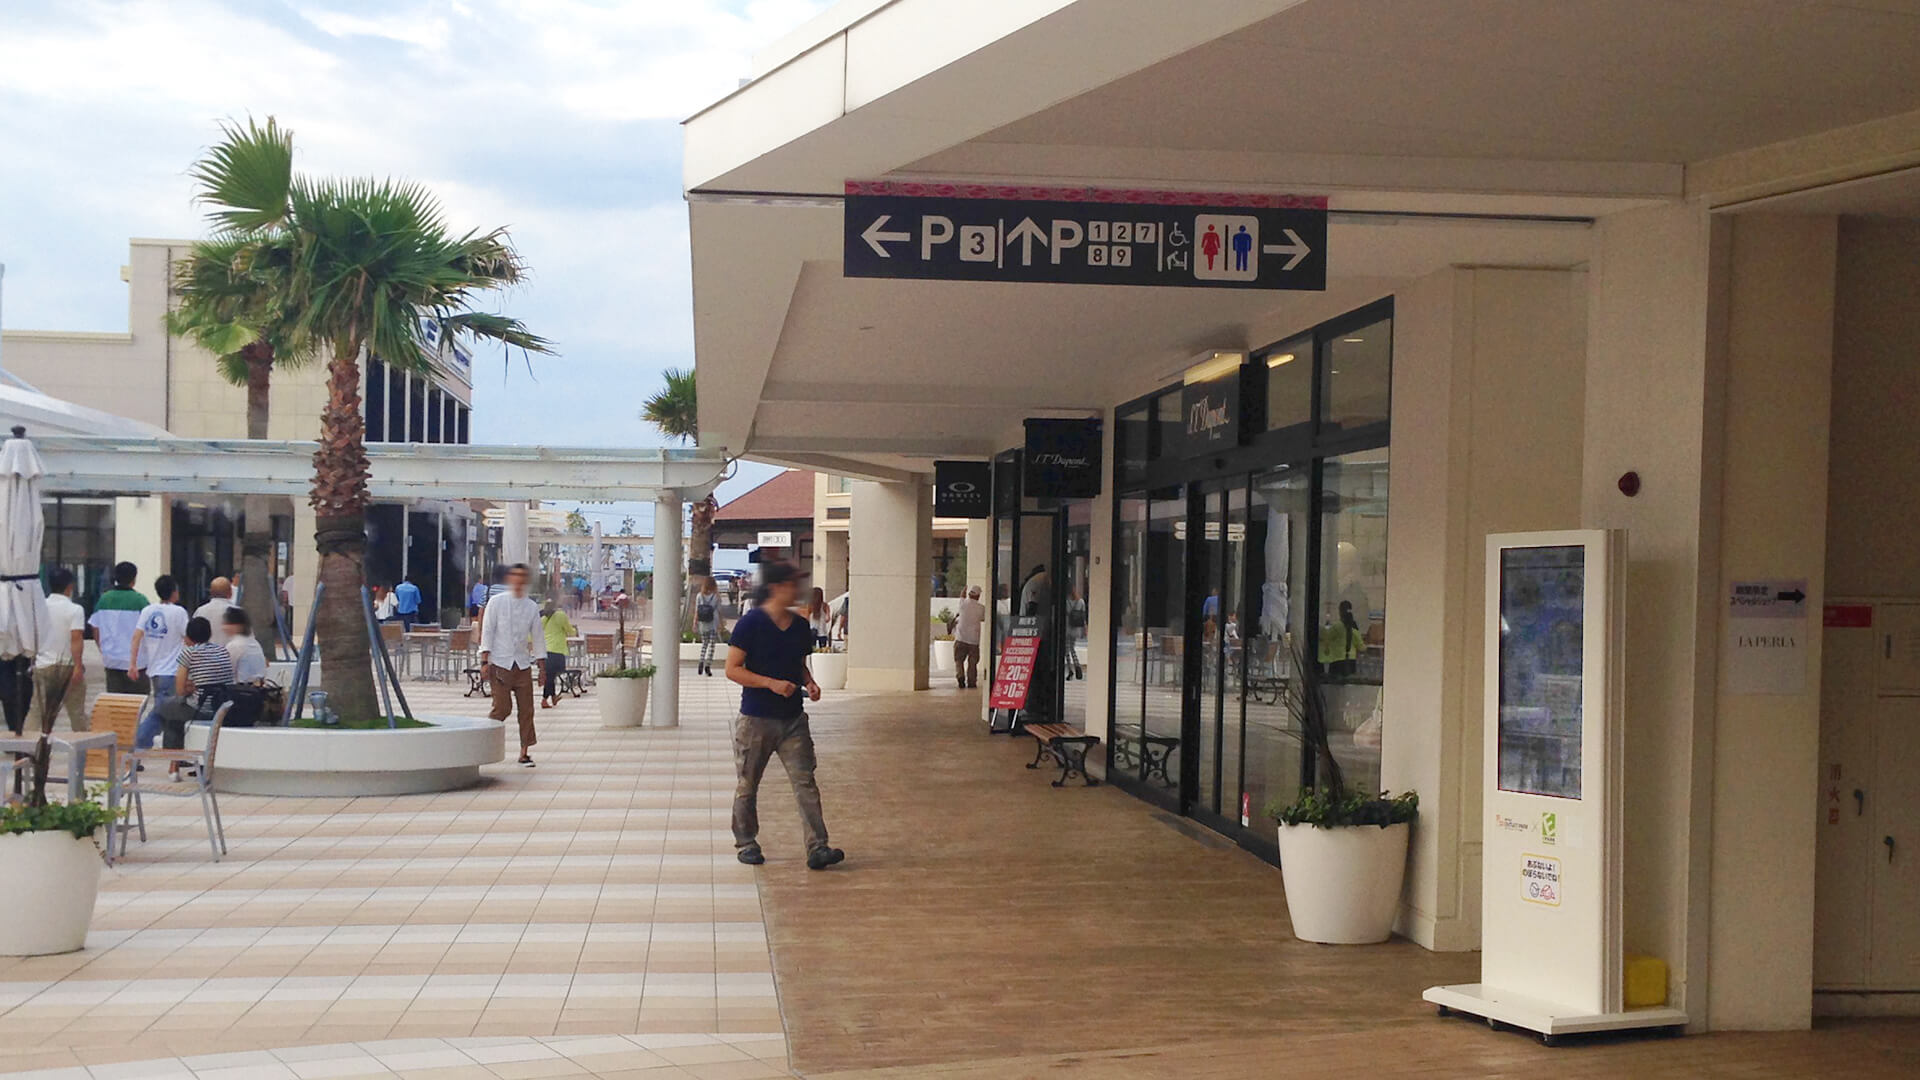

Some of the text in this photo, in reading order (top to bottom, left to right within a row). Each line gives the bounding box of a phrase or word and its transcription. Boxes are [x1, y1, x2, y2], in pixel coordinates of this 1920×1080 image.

[922, 215, 985, 260] P 3
[1051, 219, 1150, 264] P 1 2 7
[1093, 248, 1126, 263] 8 9
[1755, 636, 1794, 648] PERLA
